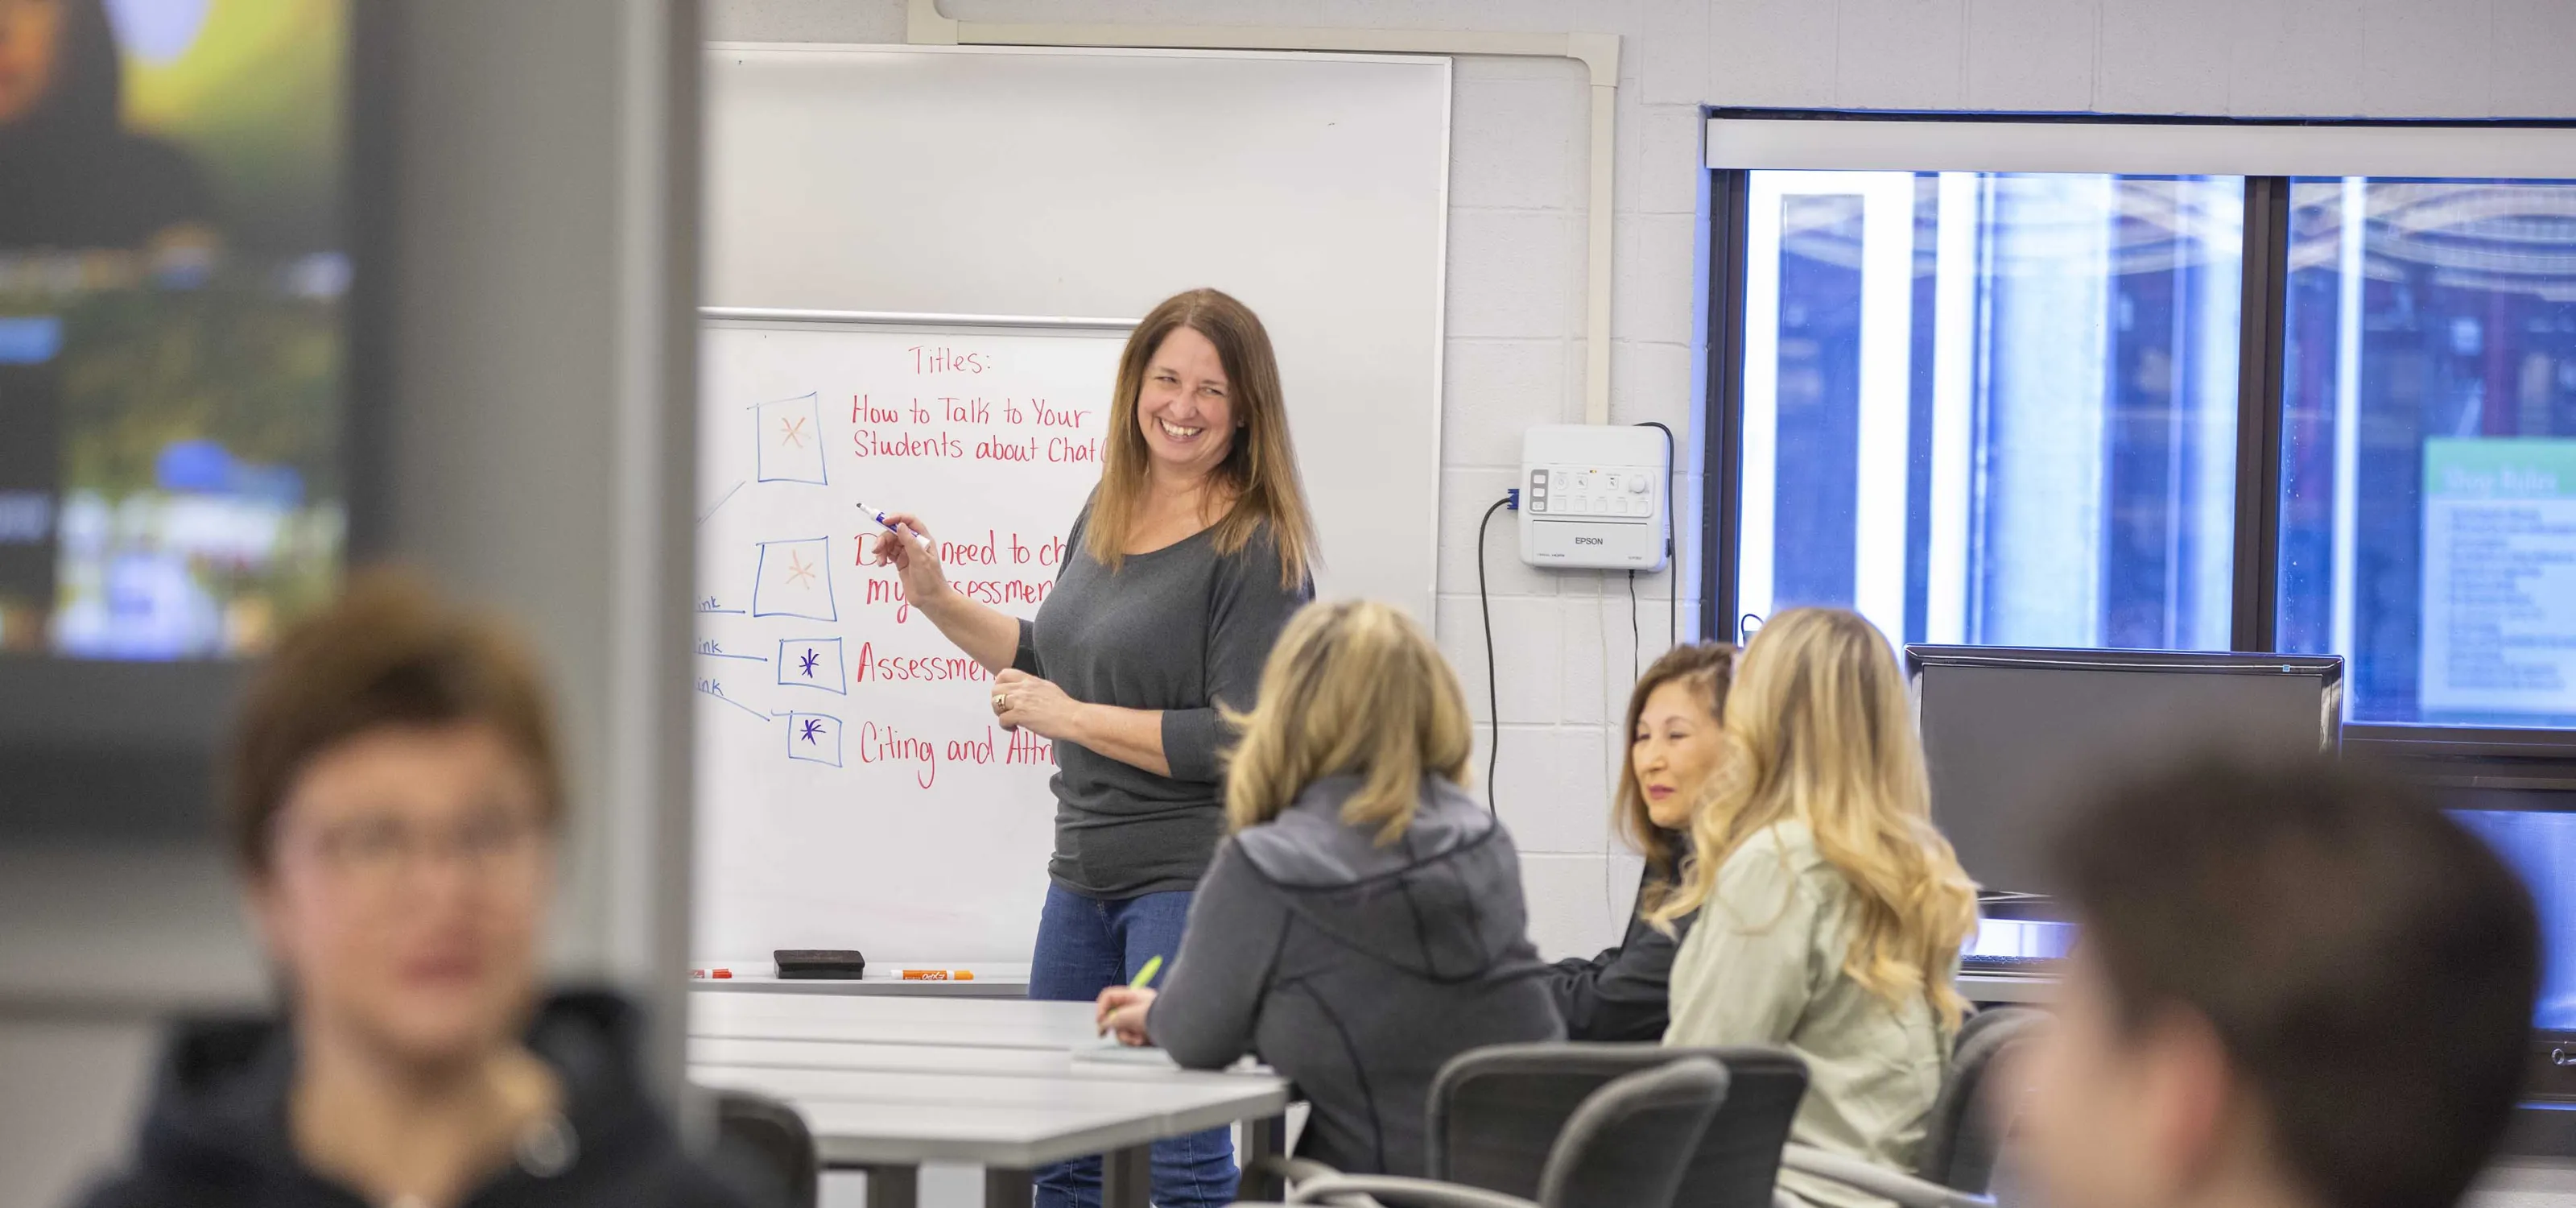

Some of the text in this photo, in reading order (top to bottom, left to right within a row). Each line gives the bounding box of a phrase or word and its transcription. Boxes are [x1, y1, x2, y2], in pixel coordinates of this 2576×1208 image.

[908, 345, 992, 374] Titles:
[852, 394, 1092, 428] How to Talk to Your
[853, 429, 964, 457] Students
[976, 435, 1039, 462] about
[941, 529, 997, 566] need
[1008, 532, 1030, 565] to
[1039, 536, 1067, 566] ch
[1575, 536, 1604, 545] EPSON
[697, 595, 721, 611] ink
[867, 578, 910, 624] my
[696, 637, 723, 654] ink
[697, 676, 724, 696] ink
[861, 721, 1055, 789] Citing and Attri
